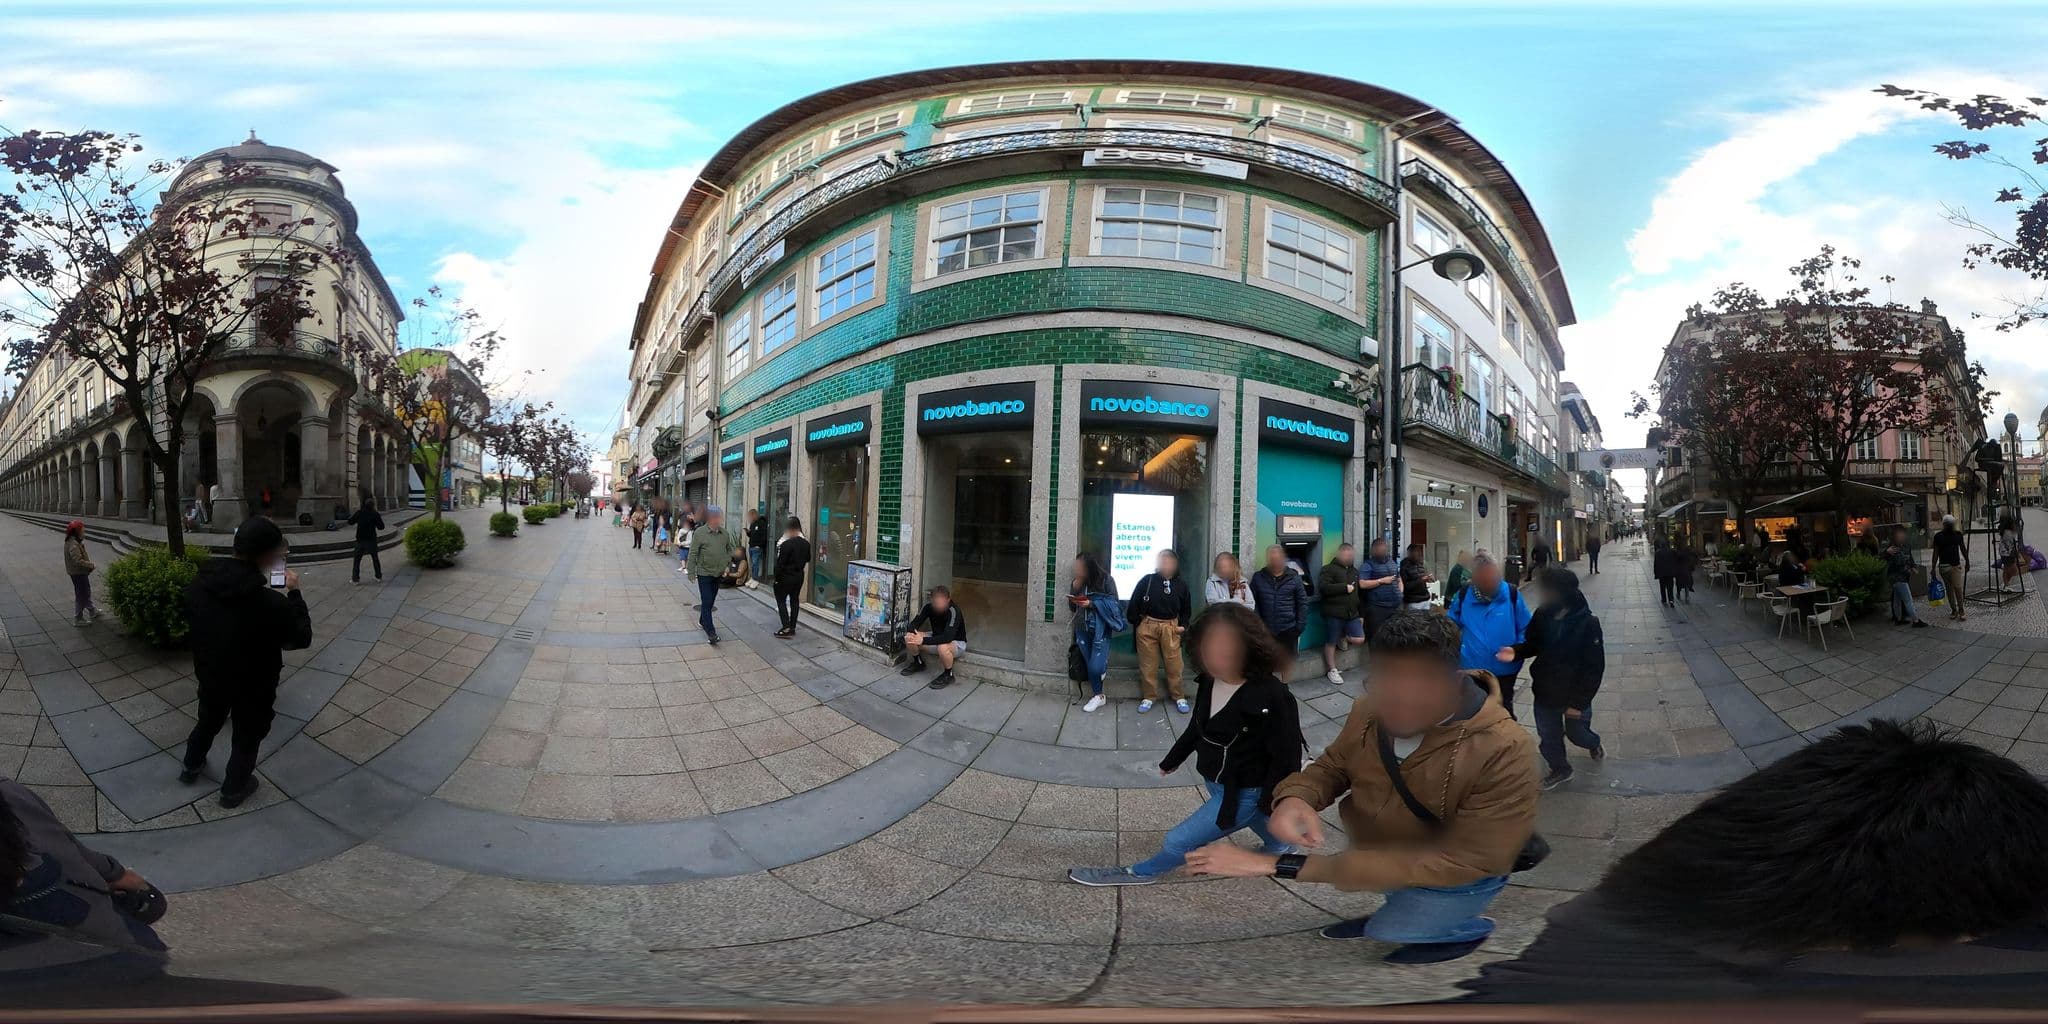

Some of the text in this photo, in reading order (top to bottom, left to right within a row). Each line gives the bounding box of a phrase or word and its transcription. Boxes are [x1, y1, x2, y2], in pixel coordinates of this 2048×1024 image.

[1094, 148, 1205, 167] Best
[923, 399, 1025, 421] novobanco
[1090, 395, 1210, 418] novobanco
[809, 420, 864, 441] novobanco
[1266, 415, 1350, 443] novobanco
[1281, 500, 1318, 509] novobanco
[1416, 495, 1444, 507] MANUEL
